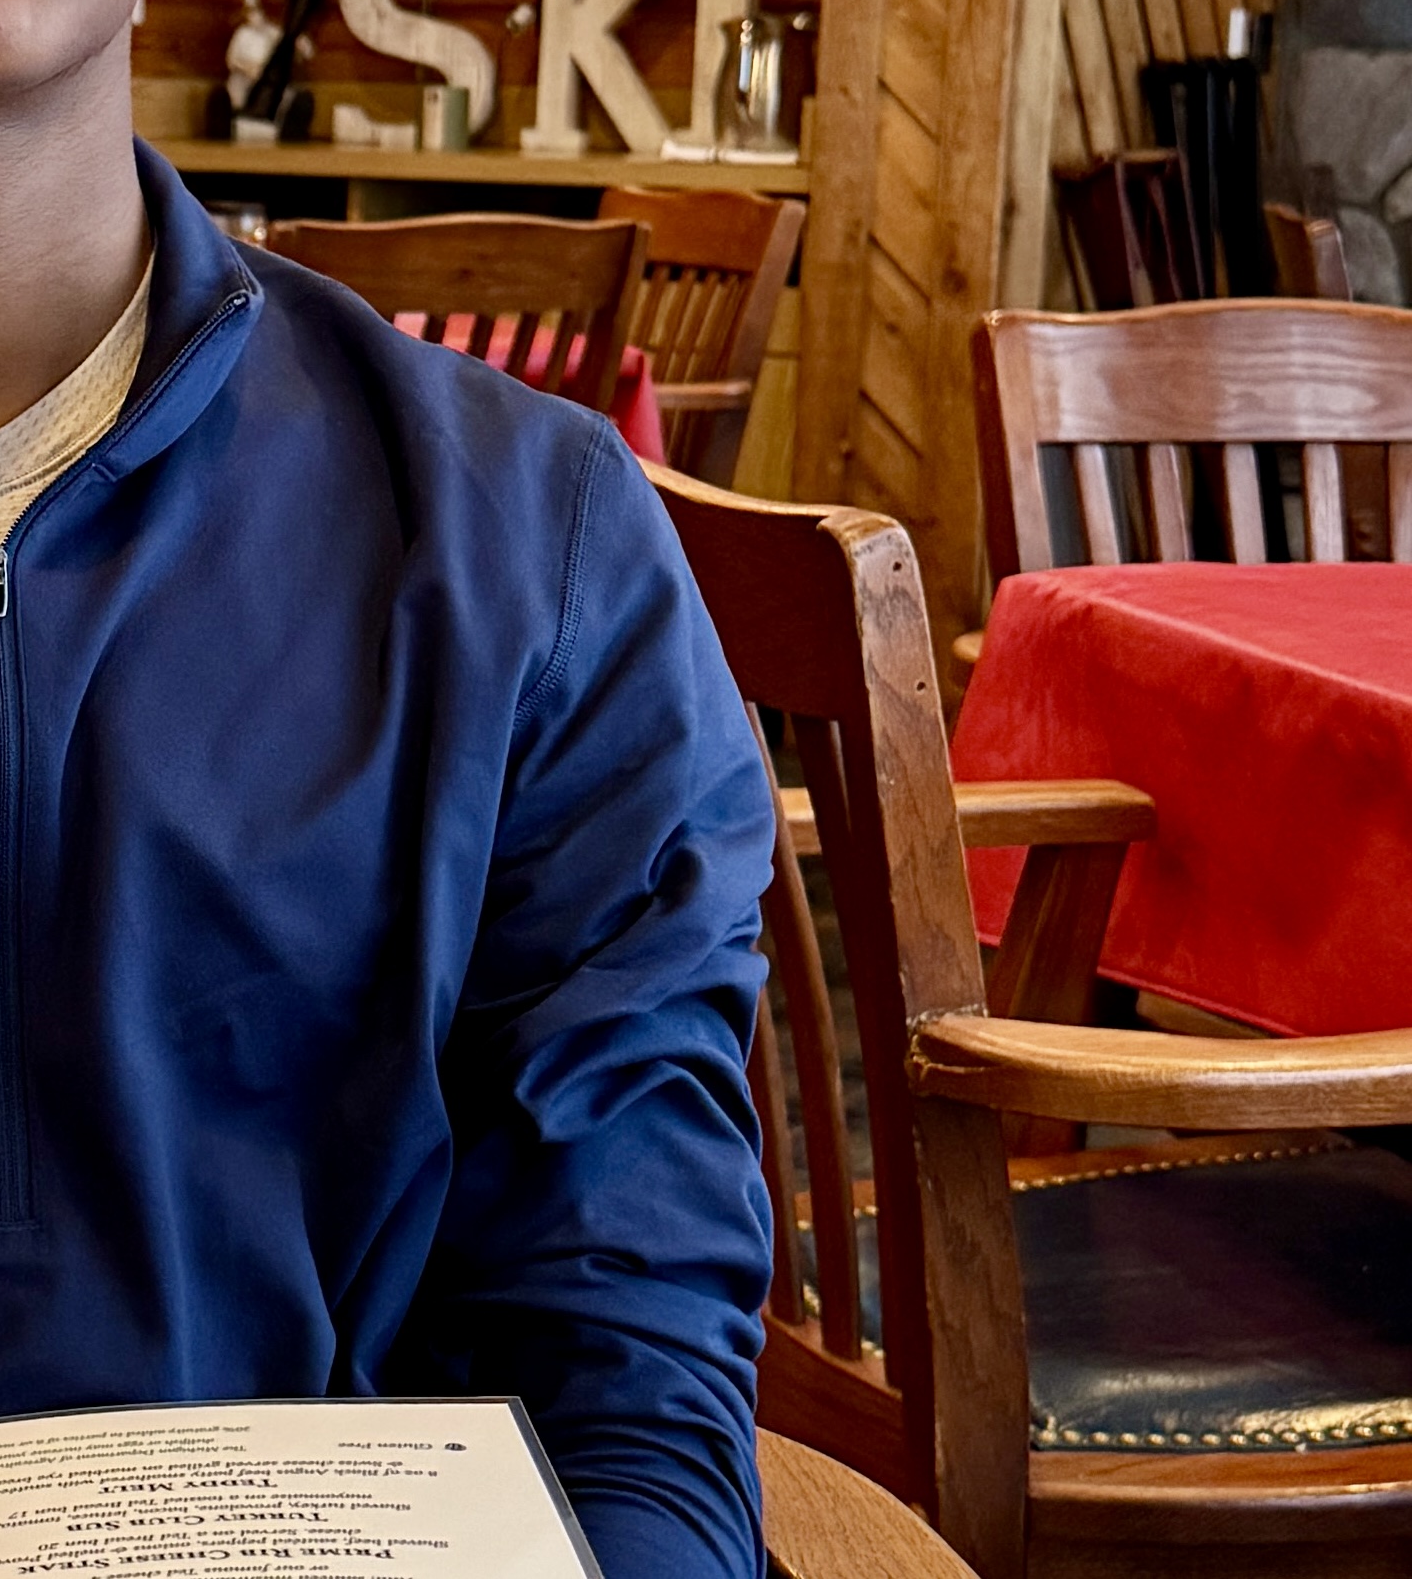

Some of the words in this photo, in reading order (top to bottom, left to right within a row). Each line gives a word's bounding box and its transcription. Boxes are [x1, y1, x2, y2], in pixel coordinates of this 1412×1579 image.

[158, 1445, 219, 1453] Michigan
[336, 1442, 372, 1450] Free
[376, 1442, 433, 1450] Gluten
[141, 1463, 164, 1471] on
[168, 1460, 221, 1471] grilled
[225, 1460, 279, 1469] served
[282, 1460, 335, 1468] cheese
[338, 1460, 383, 1468] Swiss
[36, 1471, 63, 1481] rye
[68, 1466, 137, 1479] marbled
[190, 1469, 233, 1479] patty
[236, 1468, 271, 1477] beef
[276, 1467, 330, 1476] Angus
[333, 1469, 379, 1477] Black
[382, 1468, 401, 1477] of
[99, 1472, 186, 1485] smothered
[58, 1479, 94, 1489] with
[163, 1495, 224, 1505] toasted
[269, 1491, 373, 1500] mayonnaise
[72, 1501, 122, 1513] Bread
[128, 1498, 158, 1508] Ted
[194, 1501, 283, 1512] provolone,
[288, 1501, 346, 1510] turkey,
[349, 1503, 412, 1511] Shaved
[34, 1506, 68, 1515] bun
[133, 1506, 188, 1514] bacon,
[7, 1510, 28, 1520] 17
[67, 1510, 128, 1520] lettuce,
[160, 1532, 191, 1541] Ted
[240, 1529, 298, 1537] Served
[64, 1538, 99, 1547] bun
[104, 1534, 154, 1545] Bread
[197, 1537, 267, 1546] peppers,
[343, 1537, 382, 1546] beef,
[387, 1539, 449, 1548] Shaved
[38, 1542, 60, 1551] 20
[133, 1541, 191, 1551] onions
[47, 1548, 105, 1561] melted
[167, 1568, 198, 1577] Ted
[204, 1563, 271, 1573] famous
